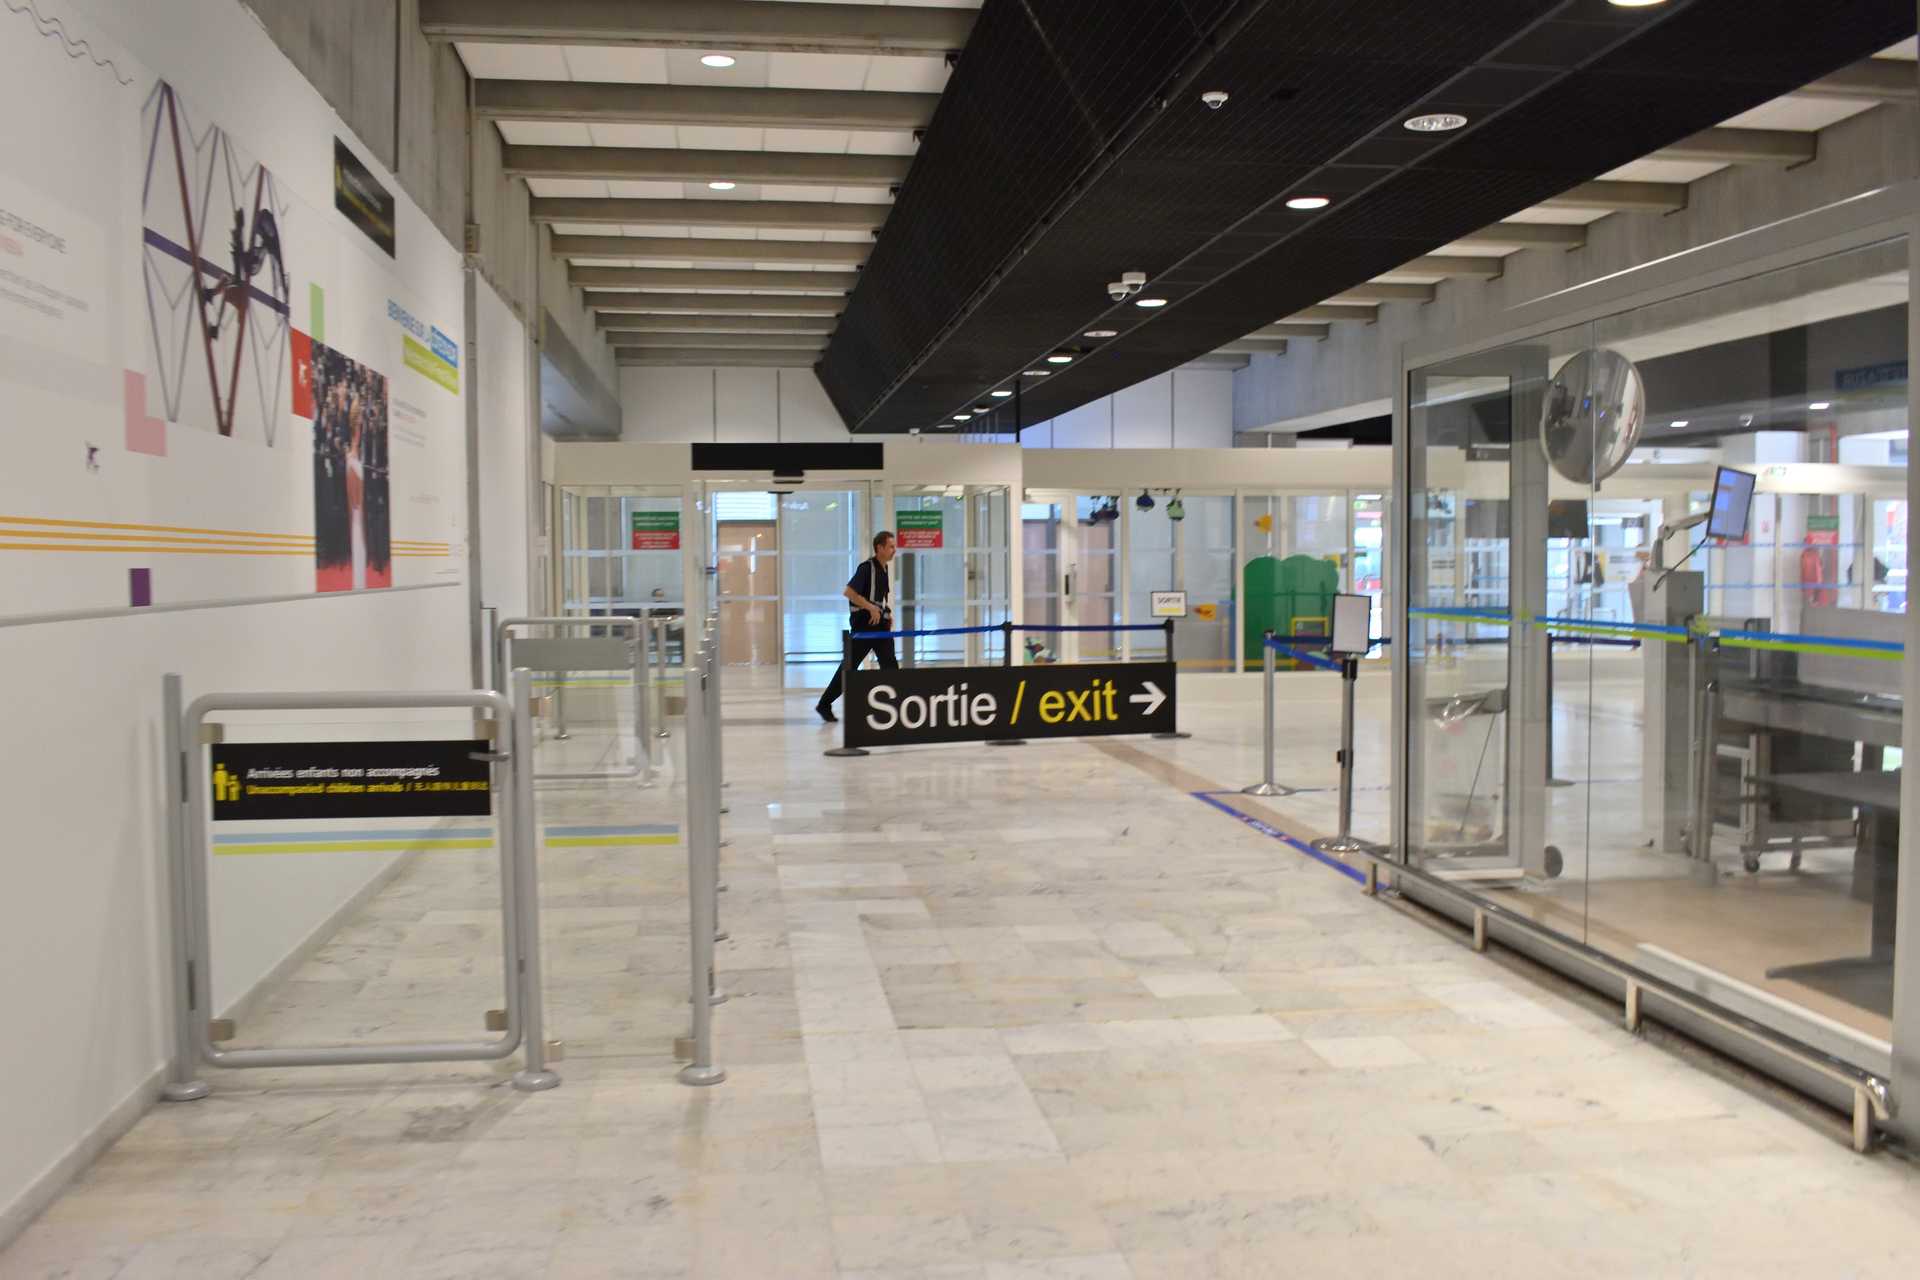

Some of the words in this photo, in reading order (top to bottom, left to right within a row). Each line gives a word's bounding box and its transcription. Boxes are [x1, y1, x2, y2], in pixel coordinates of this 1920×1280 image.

[866, 682, 997, 731] Sortie
[1009, 680, 1026, 725] /
[1039, 679, 1118, 724] exit
[247, 767, 294, 779] Arrivées
[296, 766, 339, 778] enfants
[341, 767, 364, 778] non
[366, 765, 440, 779] accompagnés
